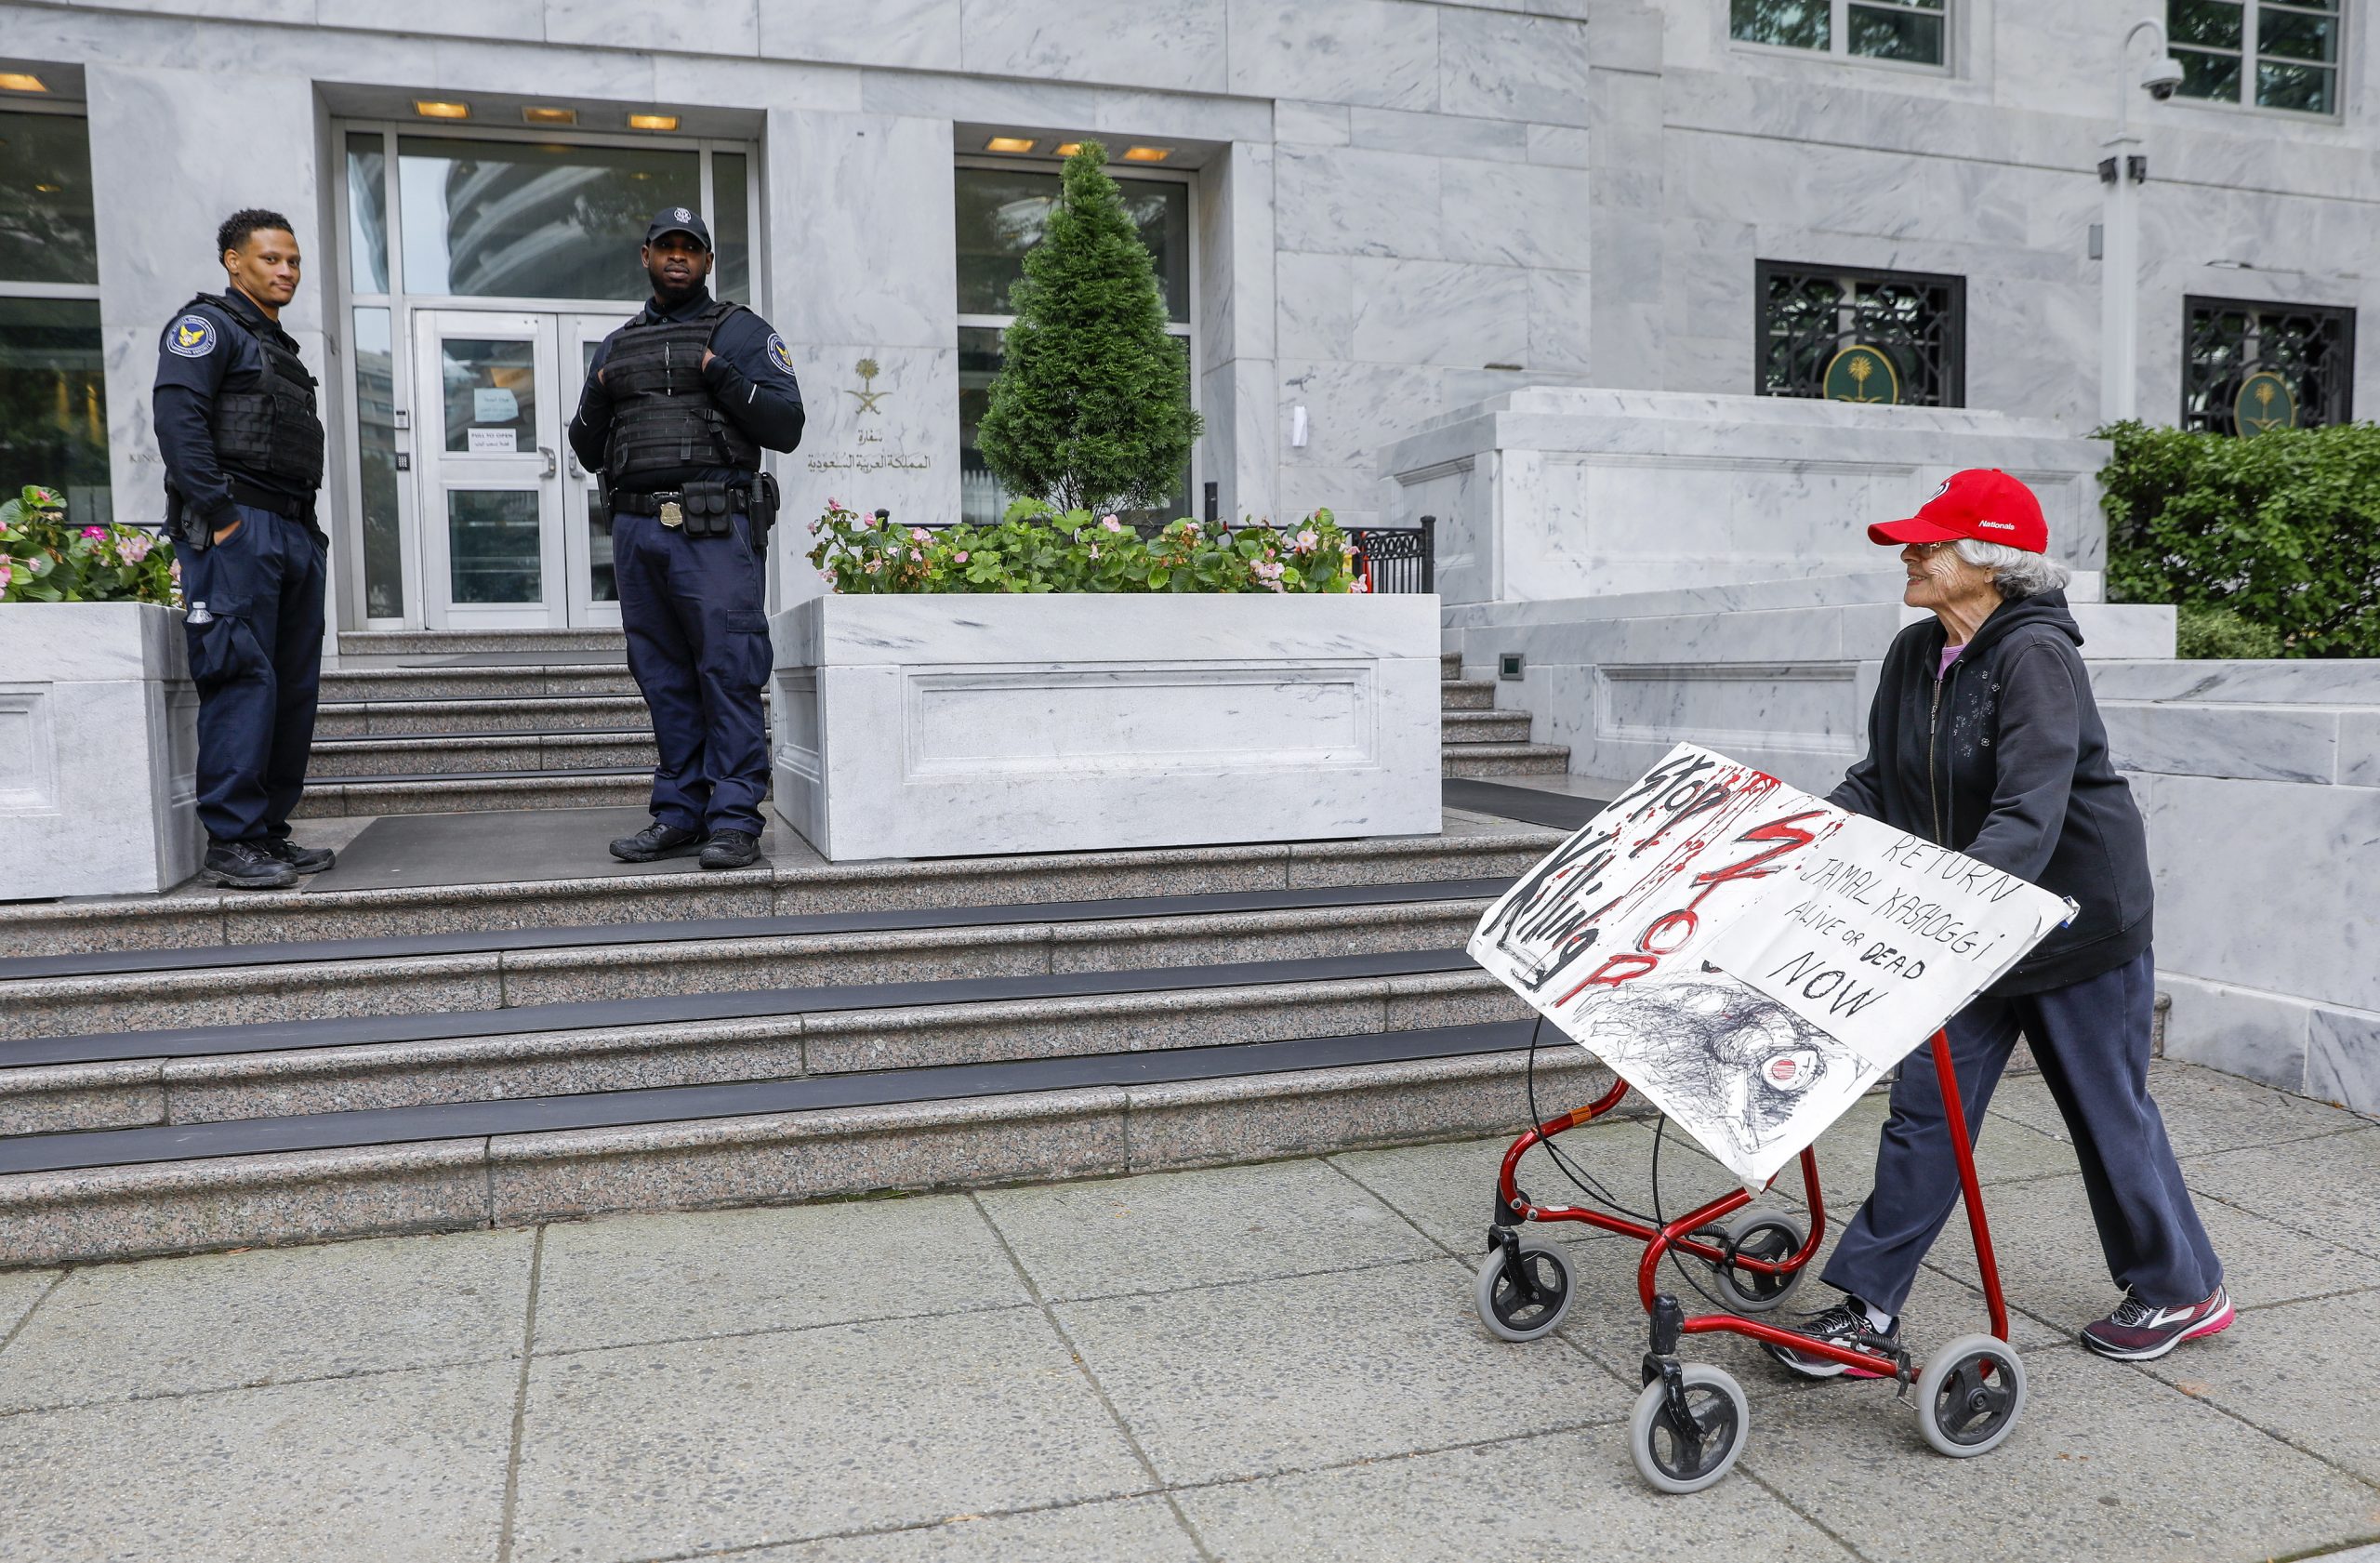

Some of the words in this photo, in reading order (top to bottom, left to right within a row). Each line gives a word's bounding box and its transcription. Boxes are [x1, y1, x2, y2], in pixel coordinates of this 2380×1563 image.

[129, 454, 163, 463] KING
[808, 452, 855, 473] السعودية
[856, 454, 887, 474] العربية
[888, 453, 932, 469] المملكة
[1978, 519, 2016, 531] Nationals
[1881, 834, 2024, 904] RETURN
[1799, 858, 1882, 906] JAMAL
[1842, 929, 1866, 947] OR
[1858, 942, 1926, 980] DEAD
[1766, 950, 1890, 1018] NOW
